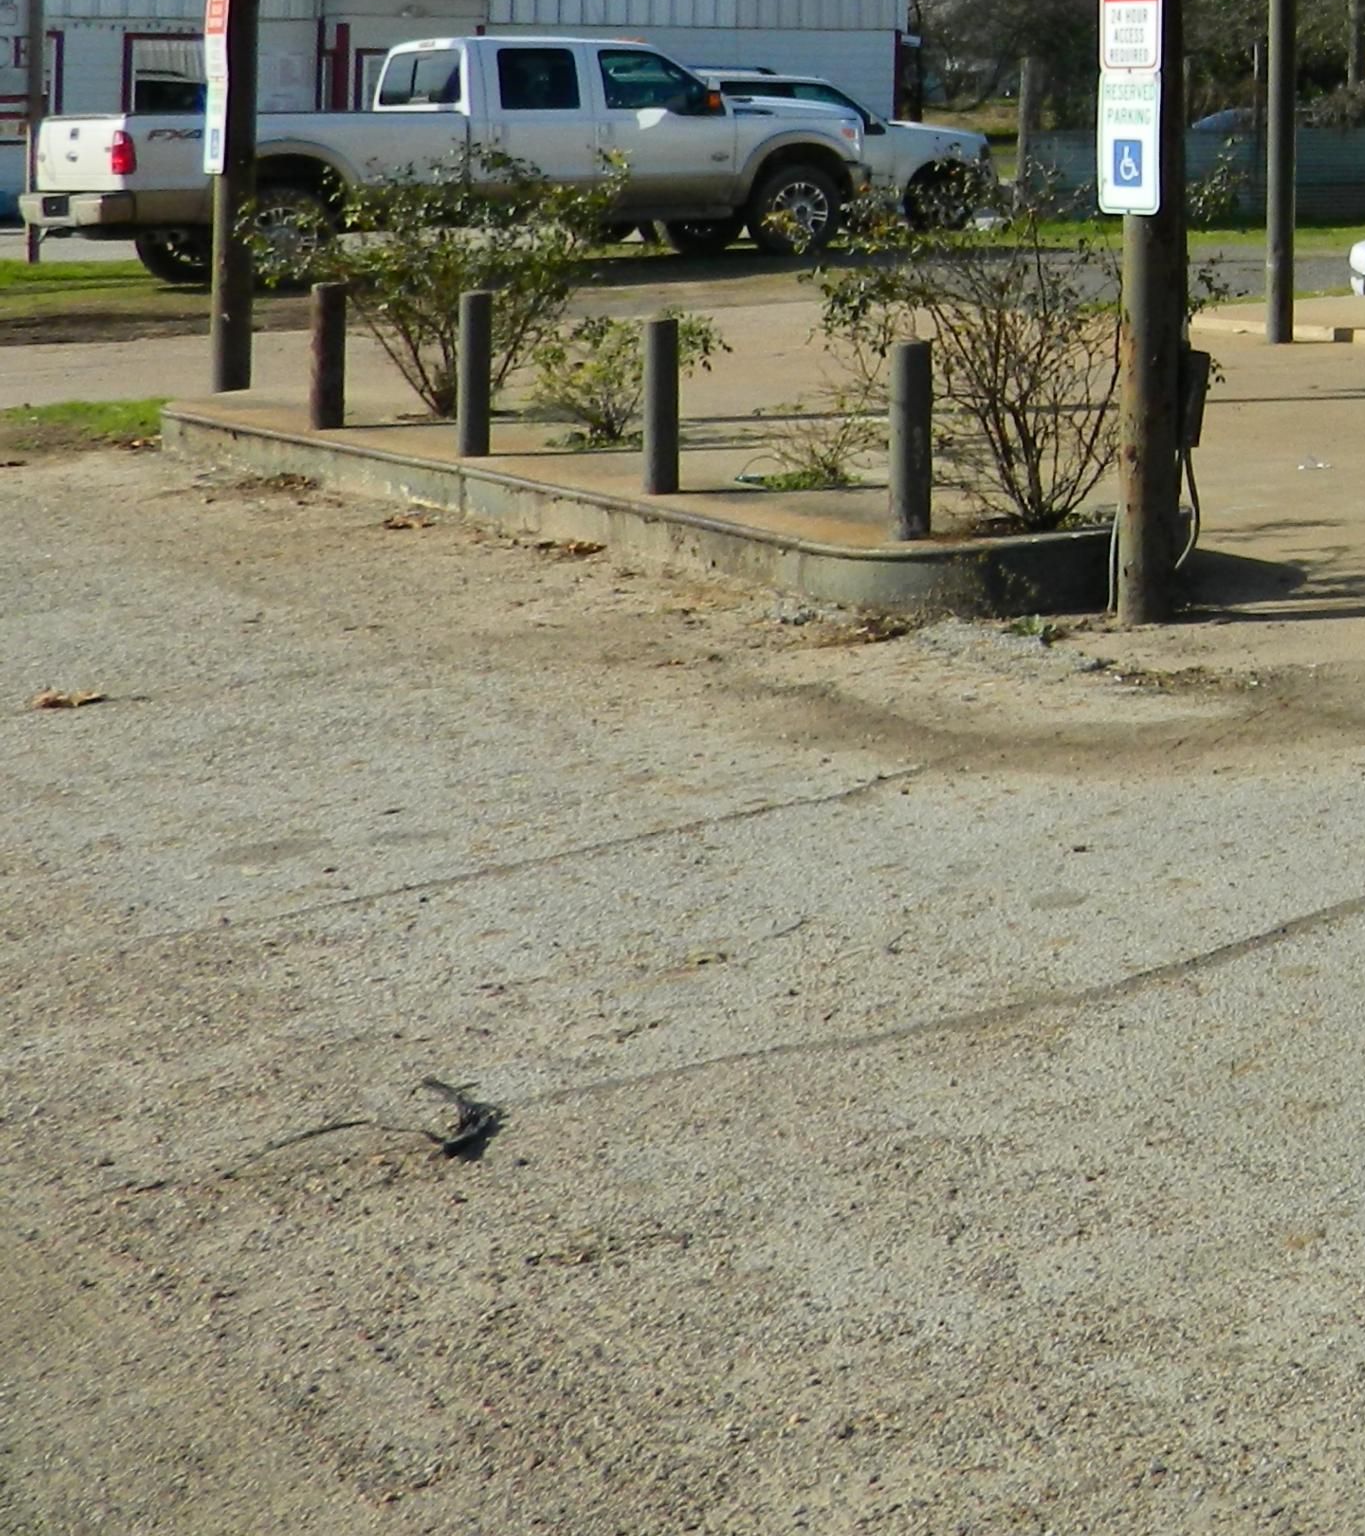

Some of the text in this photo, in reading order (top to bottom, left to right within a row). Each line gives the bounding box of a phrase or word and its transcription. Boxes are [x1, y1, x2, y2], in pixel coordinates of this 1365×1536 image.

[1111, 8, 1148, 24] 24 HOUR
[1113, 27, 1145, 44] ACCESS
[1109, 48, 1149, 63] REQUIRED
[1105, 83, 1155, 101] RESERVED
[1107, 107, 1152, 125] PARKING
[147, 128, 203, 142] FX4
